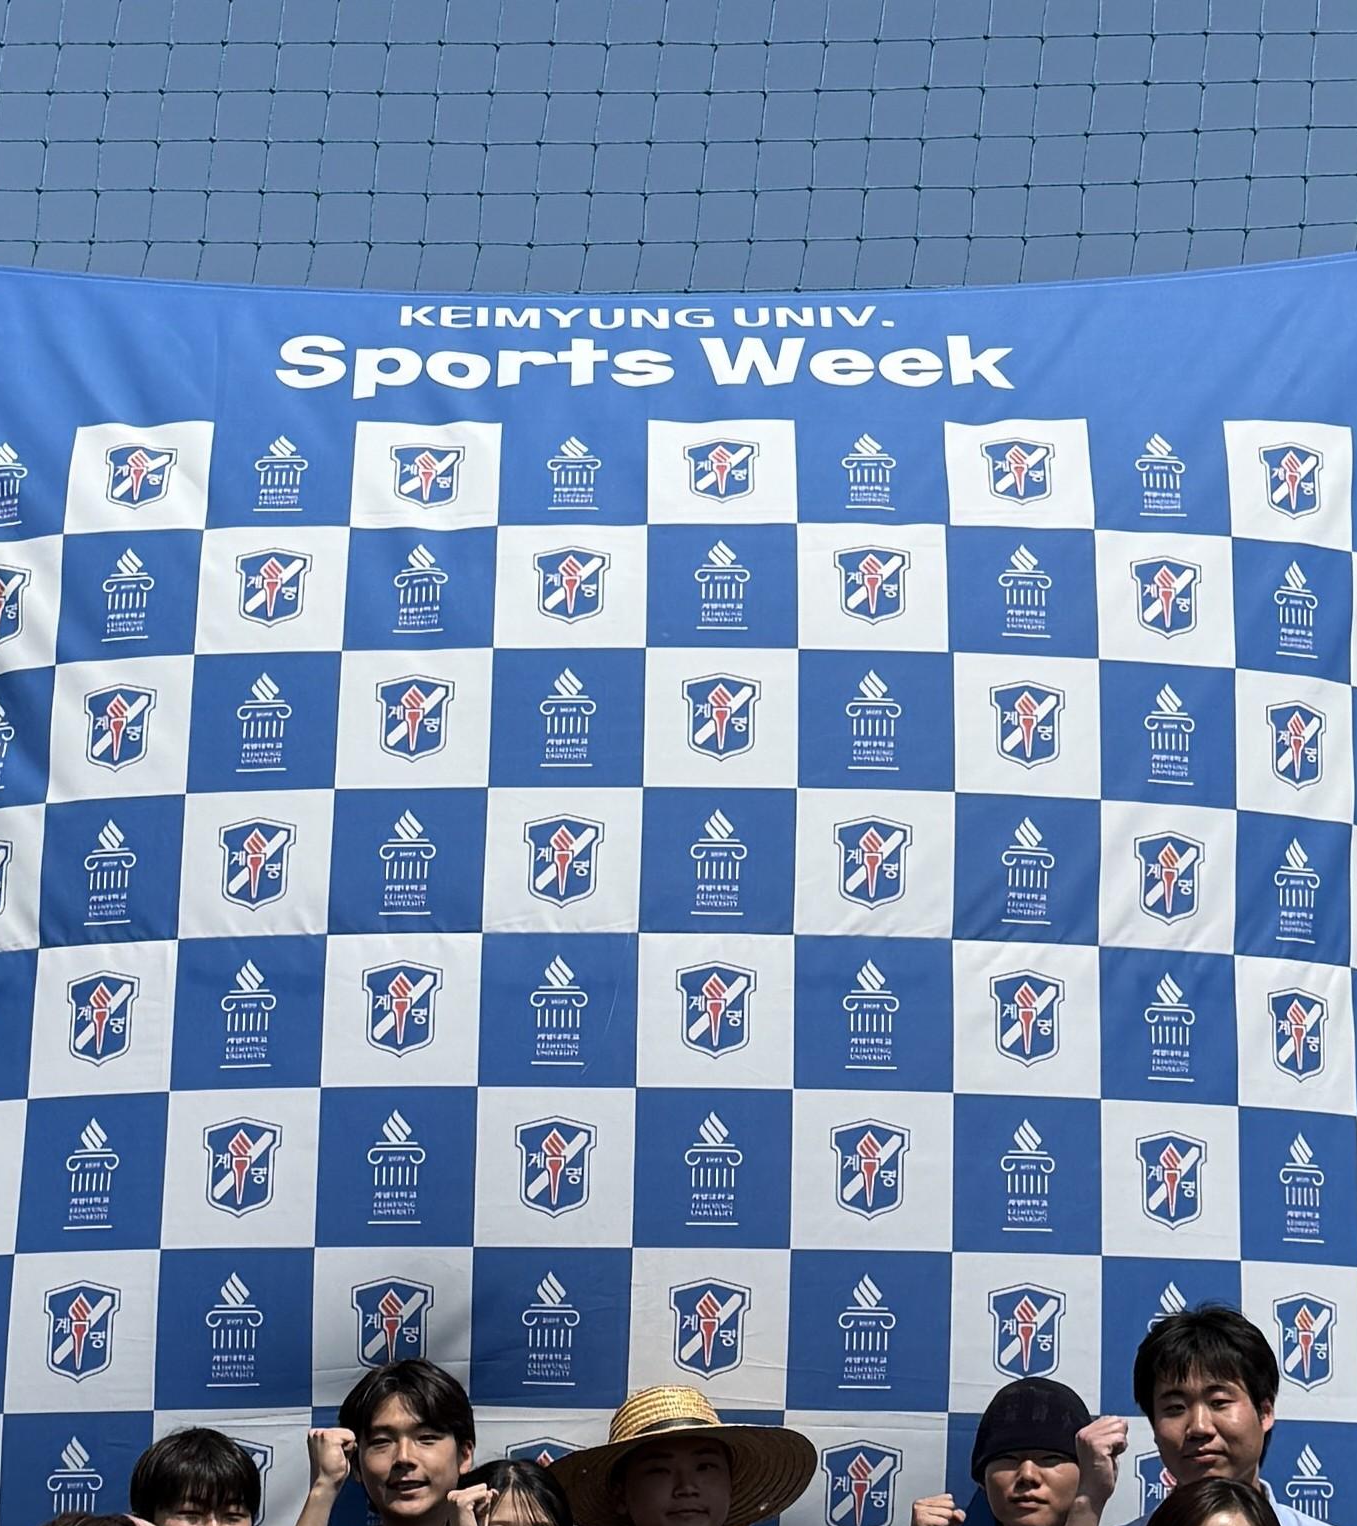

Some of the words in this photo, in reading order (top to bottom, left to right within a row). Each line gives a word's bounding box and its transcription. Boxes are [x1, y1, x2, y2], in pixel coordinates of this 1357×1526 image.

[400, 305, 715, 330] KEIMYUNG
[733, 305, 895, 328] UNIV.
[275, 334, 675, 400] Sports
[699, 334, 1015, 390] Week
[115, 465, 130, 476] 계
[147, 474, 162, 485] 명
[402, 464, 417, 475] 계
[437, 476, 452, 488] 명
[696, 460, 711, 471] 계
[732, 469, 747, 480] 명
[993, 461, 1007, 472] 계
[1029, 470, 1044, 482] 명
[247, 576, 262, 588] 계
[282, 587, 296, 600] 명
[546, 574, 560, 586] 계
[581, 584, 597, 597] 명
[847, 572, 862, 584] 계
[882, 584, 898, 598] 명
[1141, 584, 1156, 597] 계
[1176, 598, 1190, 612] 명
[95, 716, 109, 730] 계
[127, 726, 142, 740] 명
[388, 705, 403, 720] 계
[424, 718, 440, 732] 명
[695, 704, 710, 718] 계
[731, 717, 747, 732] 명
[1003, 711, 1018, 726] 계
[1038, 726, 1052, 740] 명
[1276, 732, 1288, 746] 계
[1305, 748, 1317, 762] 명
[230, 851, 246, 866] 계
[266, 863, 281, 878] 명
[537, 847, 552, 862] 계
[573, 860, 589, 876] 명
[846, 849, 862, 864] 계
[883, 863, 898, 878] 명
[1147, 864, 1160, 879] 계
[1178, 880, 1192, 895] 명
[77, 1006, 91, 1020] 계
[110, 1017, 125, 1034] 명
[375, 994, 390, 1010] 계
[412, 1008, 427, 1024] 명
[689, 995, 705, 1011] 계
[726, 1010, 742, 1026] 명
[1003, 1004, 1017, 1019] 계
[1037, 1019, 1052, 1035] 명
[1278, 1020, 1290, 1035] 계
[1307, 1036, 1319, 1052] 명
[215, 1153, 230, 1168] 계
[251, 1167, 267, 1184] 명
[528, 1152, 544, 1168] 계
[566, 1167, 582, 1184] 명
[844, 1156, 860, 1172] 계
[880, 1170, 896, 1187] 명
[1148, 1165, 1162, 1181] 계
[1181, 1182, 1195, 1197] 명
[55, 1318, 70, 1334] 계
[90, 1331, 105, 1348] 명
[365, 1312, 382, 1329] 계
[403, 1326, 418, 1343] 명
[682, 1314, 698, 1331] 계
[720, 1330, 736, 1346] 명
[1002, 1319, 1016, 1335] 계
[1038, 1335, 1052, 1351] 명
[1285, 1327, 1297, 1342] 계
[1314, 1343, 1327, 1359] 명
[834, 1476, 850, 1492] 계
[871, 1491, 887, 1507] 명
[1147, 1483, 1162, 1502] 계
